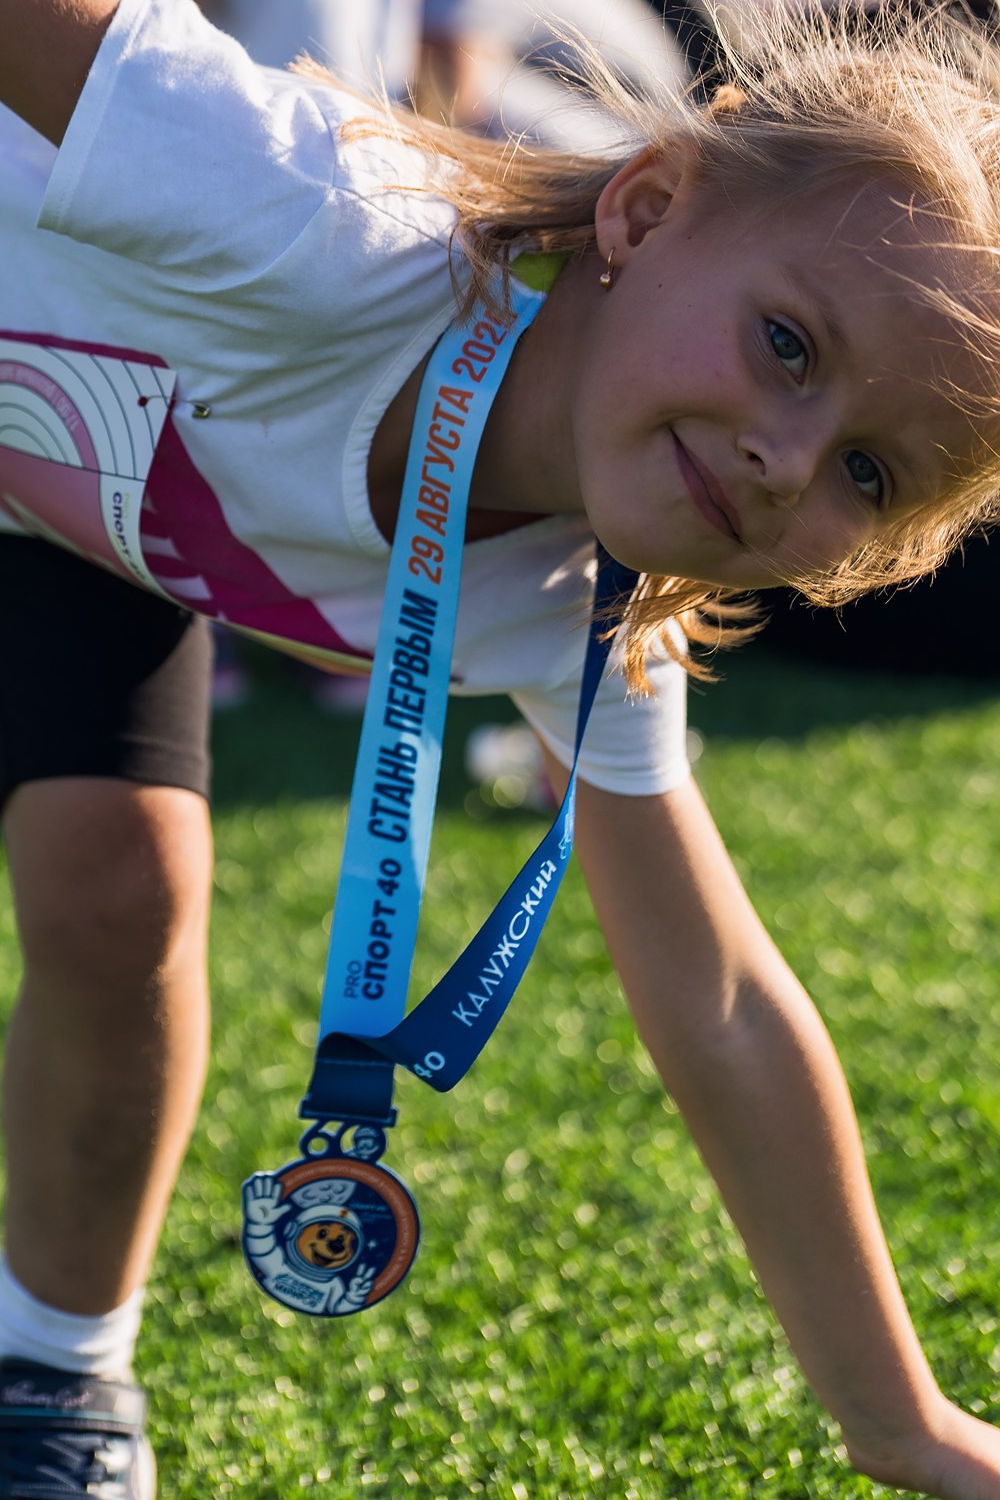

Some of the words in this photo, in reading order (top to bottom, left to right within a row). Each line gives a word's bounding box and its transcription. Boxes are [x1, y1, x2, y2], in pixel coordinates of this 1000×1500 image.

[415, 384, 475, 538] АВГУСТА
[407, 536, 445, 586] 29
[383, 588, 439, 738] ПЕРВЫМ
[368, 740, 418, 844] СТАНЬ
[376, 858, 403, 898] 40
[344, 960, 363, 1000] PRO
[362, 900, 398, 1001] СПОРТ
[413, 1051, 446, 1079] 40
[451, 859, 557, 1028] КАЛУЖСКИЙ
